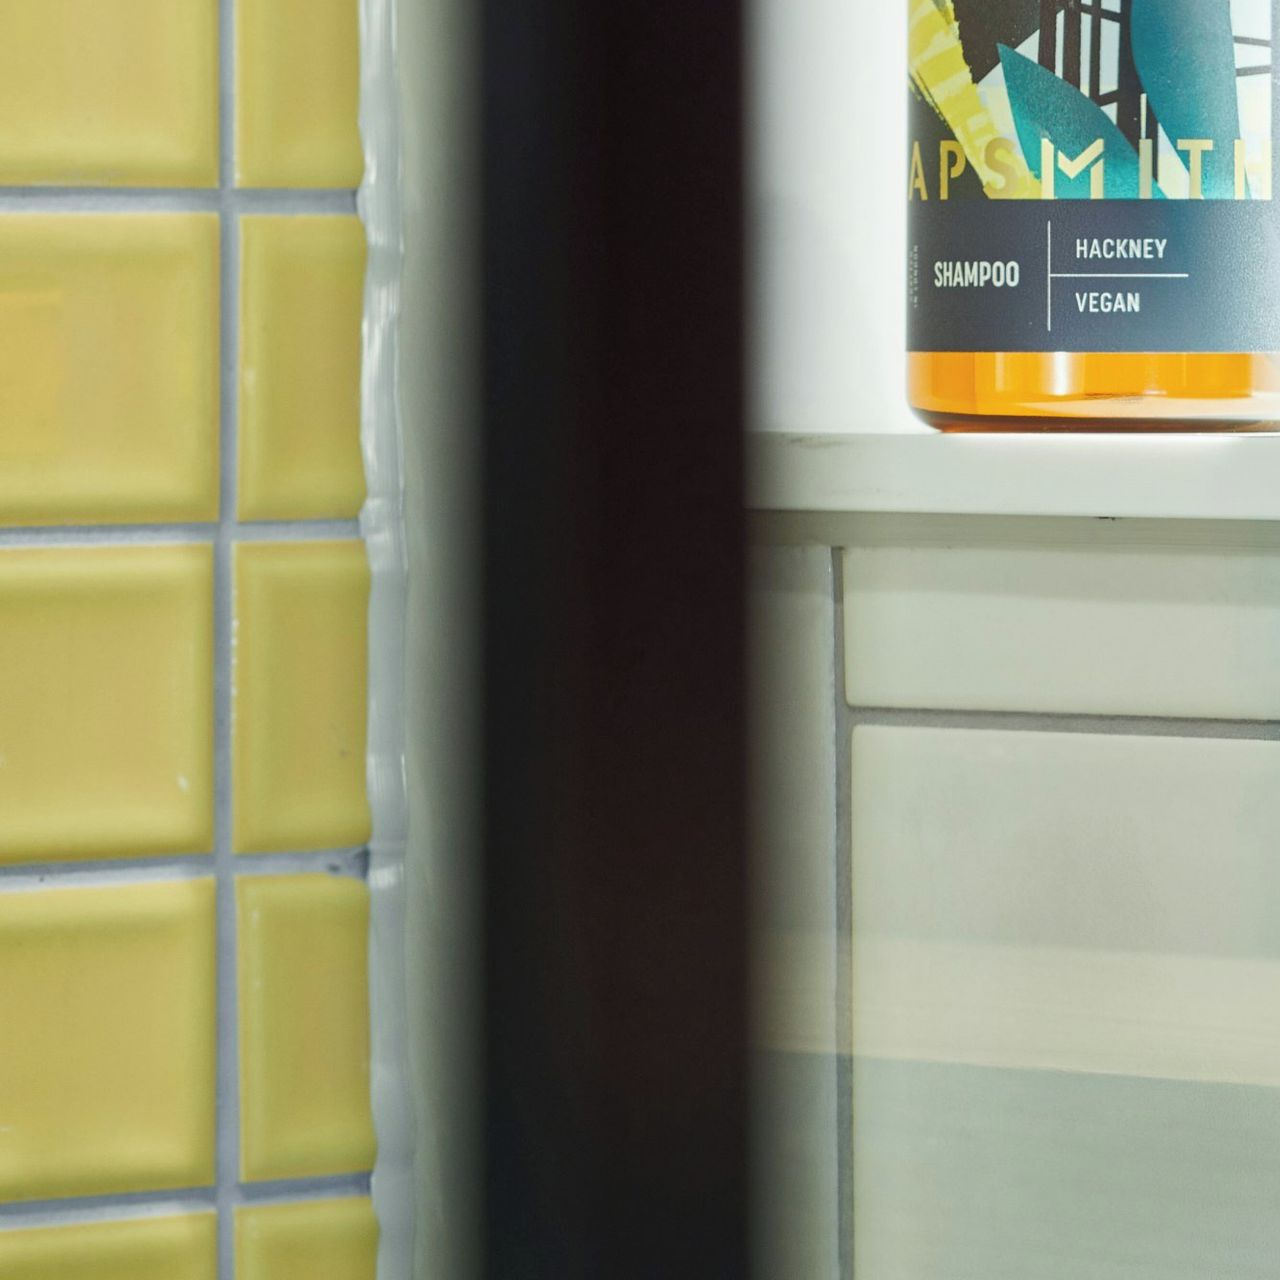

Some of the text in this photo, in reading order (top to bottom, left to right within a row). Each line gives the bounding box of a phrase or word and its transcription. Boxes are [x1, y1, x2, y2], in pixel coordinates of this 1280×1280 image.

[1075, 238, 1167, 259] HACKNEY
[934, 260, 1020, 287] SHAMPOO
[1075, 292, 1140, 312] VEGAN
